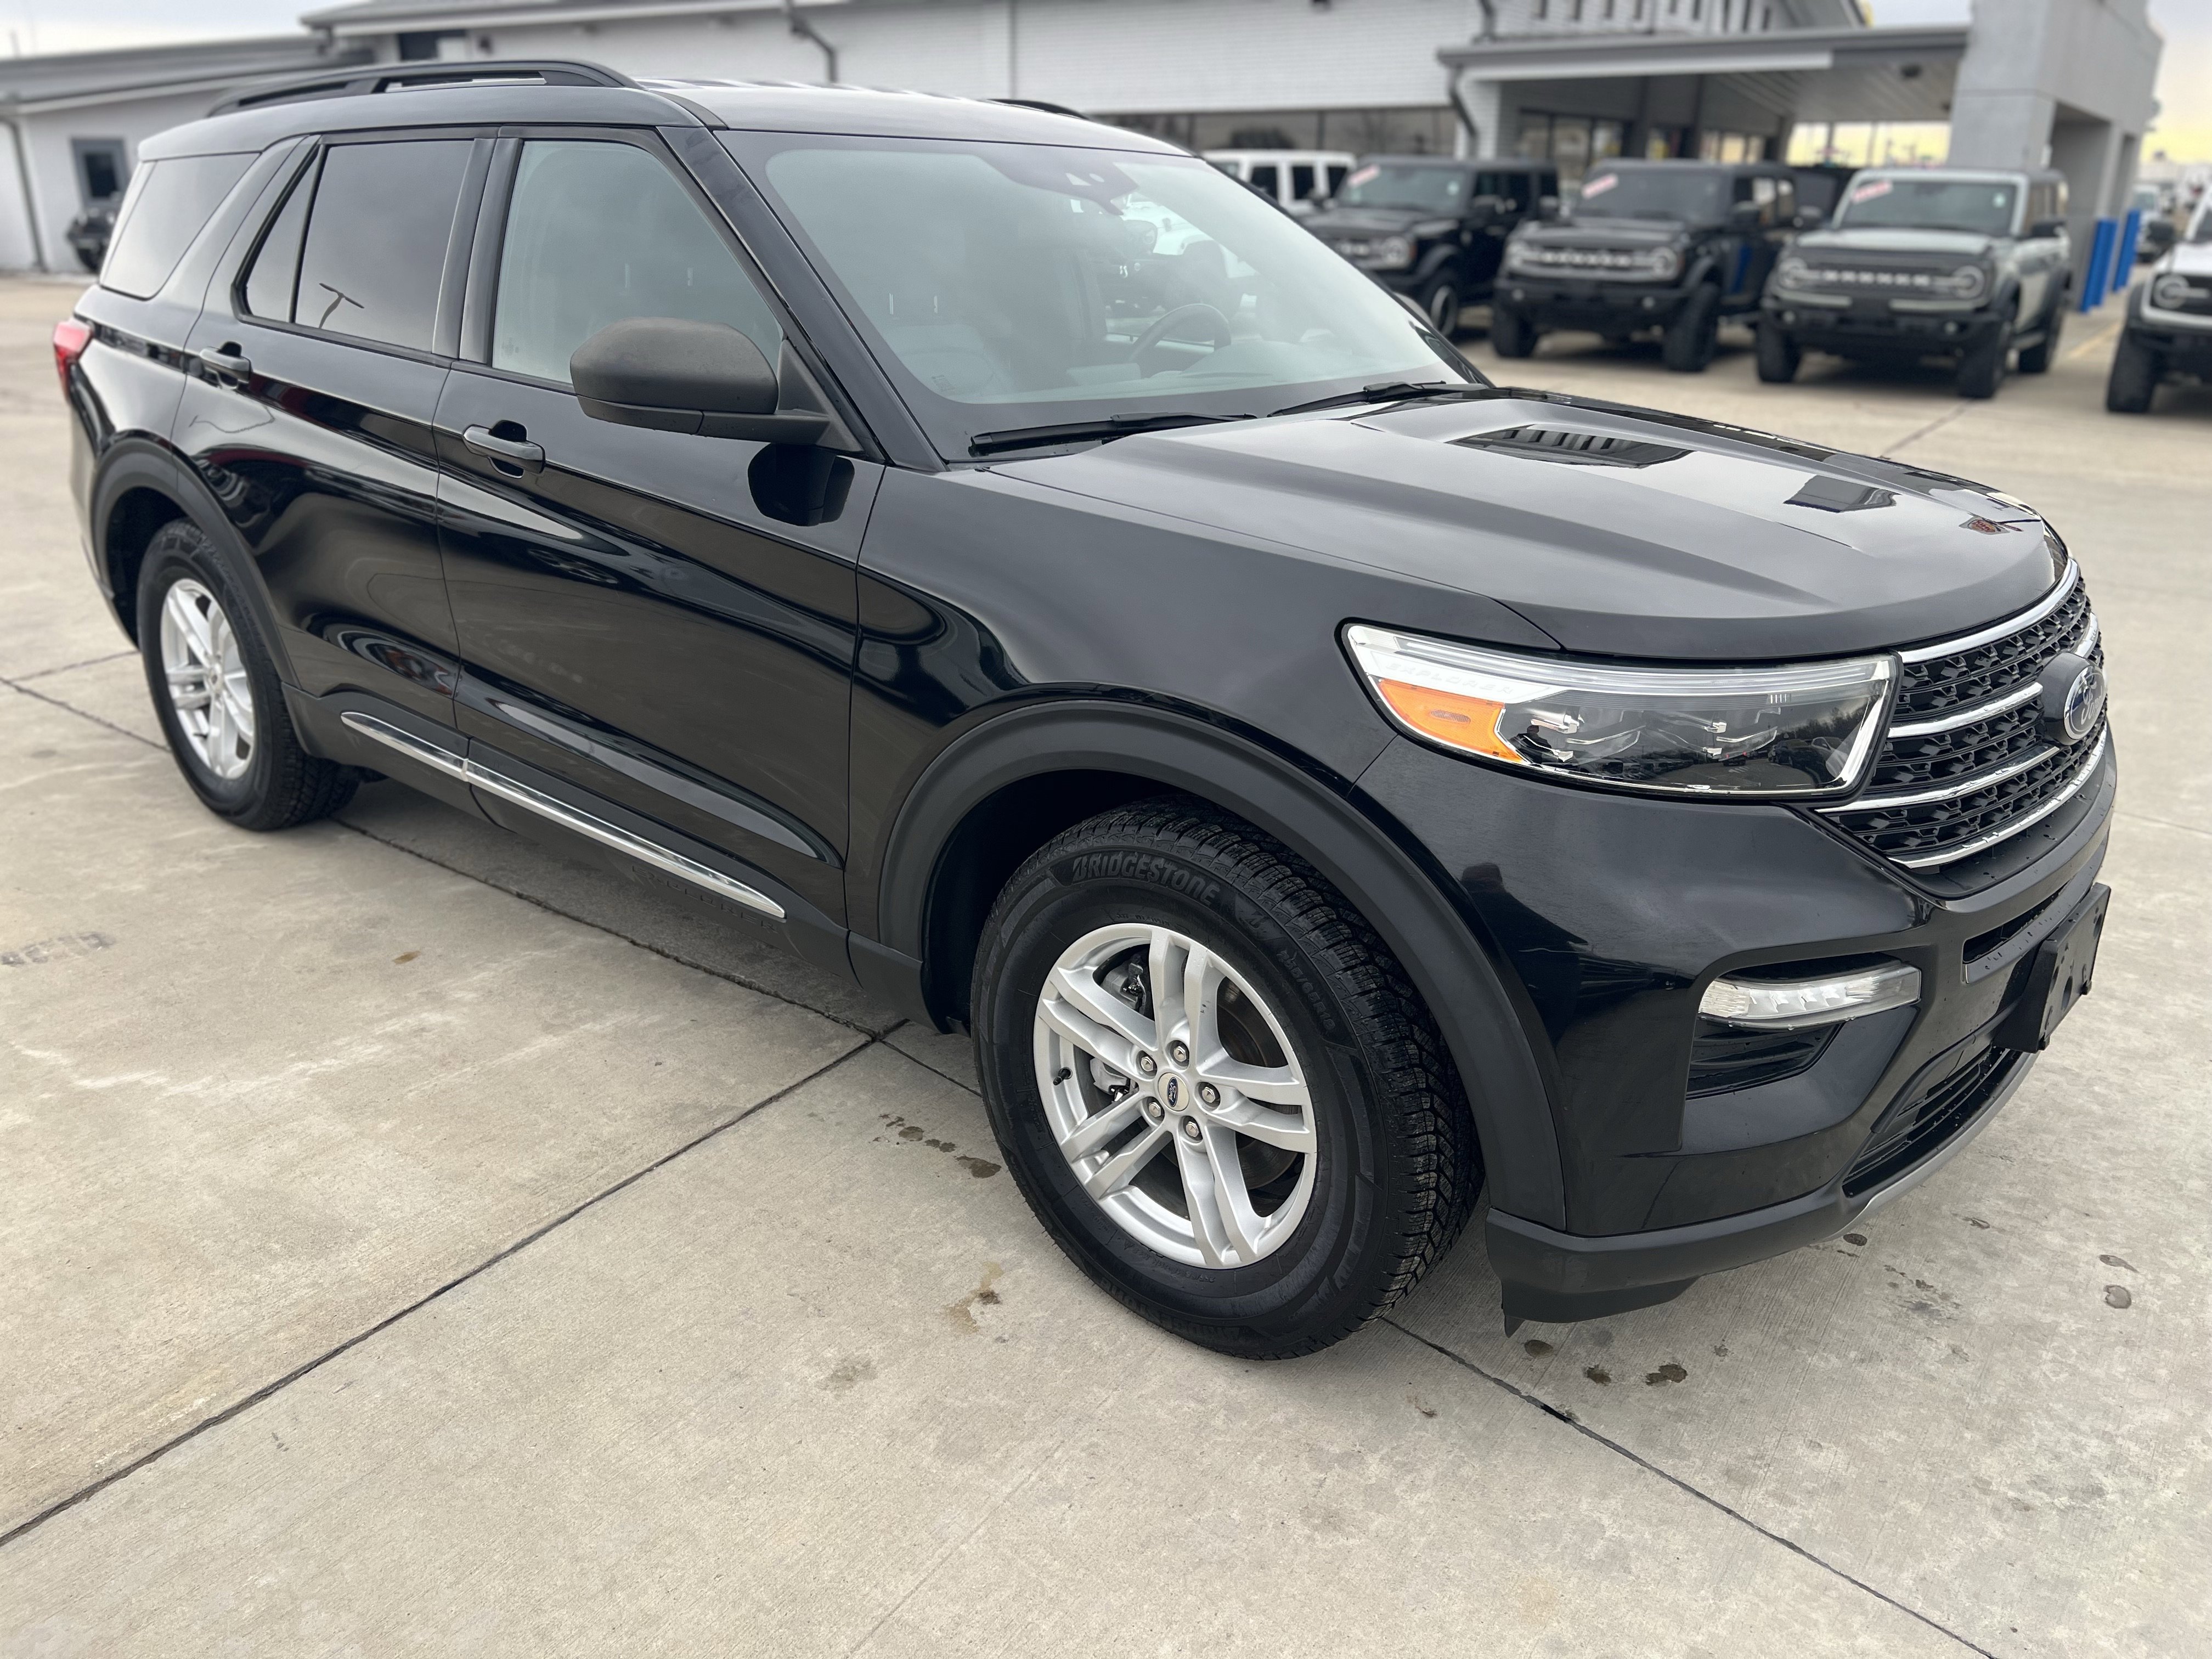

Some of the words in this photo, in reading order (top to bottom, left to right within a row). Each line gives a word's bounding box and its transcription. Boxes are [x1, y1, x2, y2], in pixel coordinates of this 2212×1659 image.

[1385, 663, 1515, 694] EXPLORER
[632, 866, 778, 934] EXPLORER
[1072, 851, 1221, 905] BRIDGESTONE
